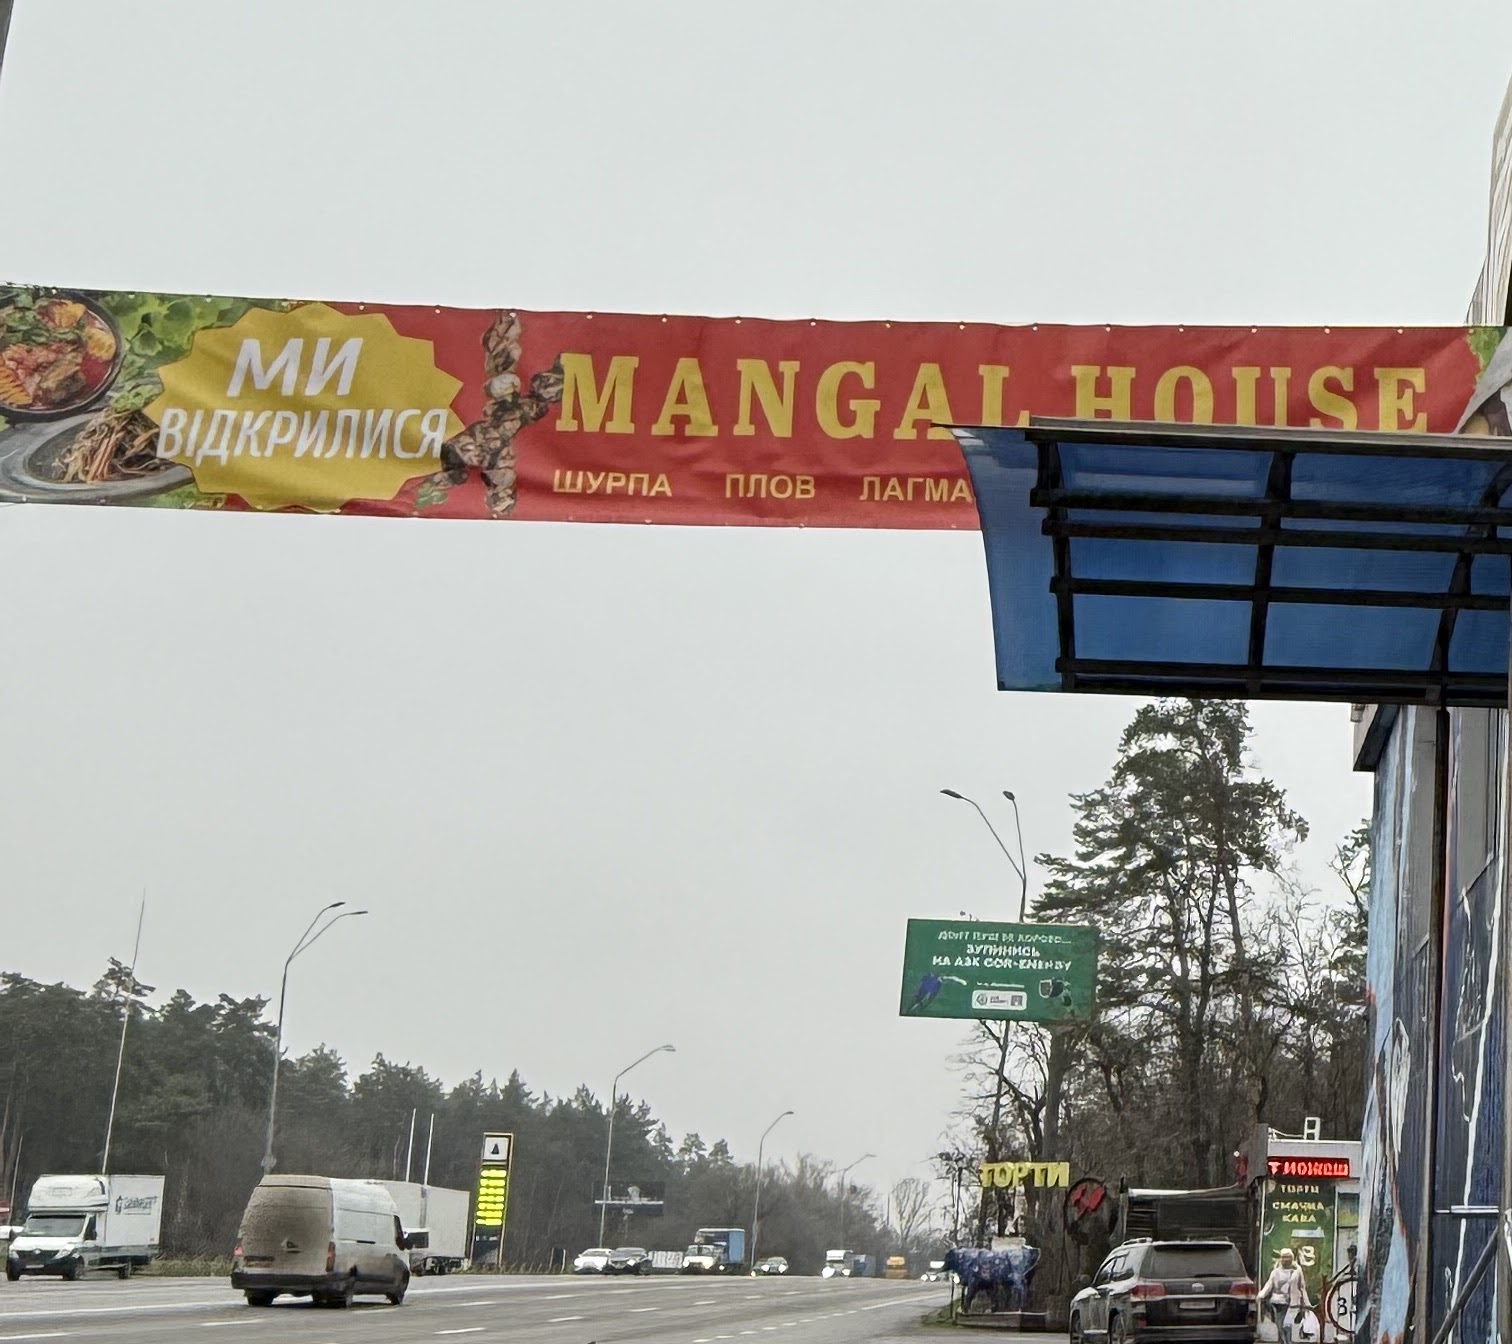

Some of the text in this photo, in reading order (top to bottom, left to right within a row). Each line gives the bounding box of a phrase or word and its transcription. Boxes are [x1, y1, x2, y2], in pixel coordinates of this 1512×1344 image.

[226, 337, 364, 397] МИ
[555, 352, 1429, 440] MANGAL HOUSE
[155, 407, 449, 467] ВІДКРИЛИСЯ
[552, 468, 974, 503] ШУРПА ПЛОВ ЛАГМА
[979, 1161, 1070, 1188] ТОРТИ
